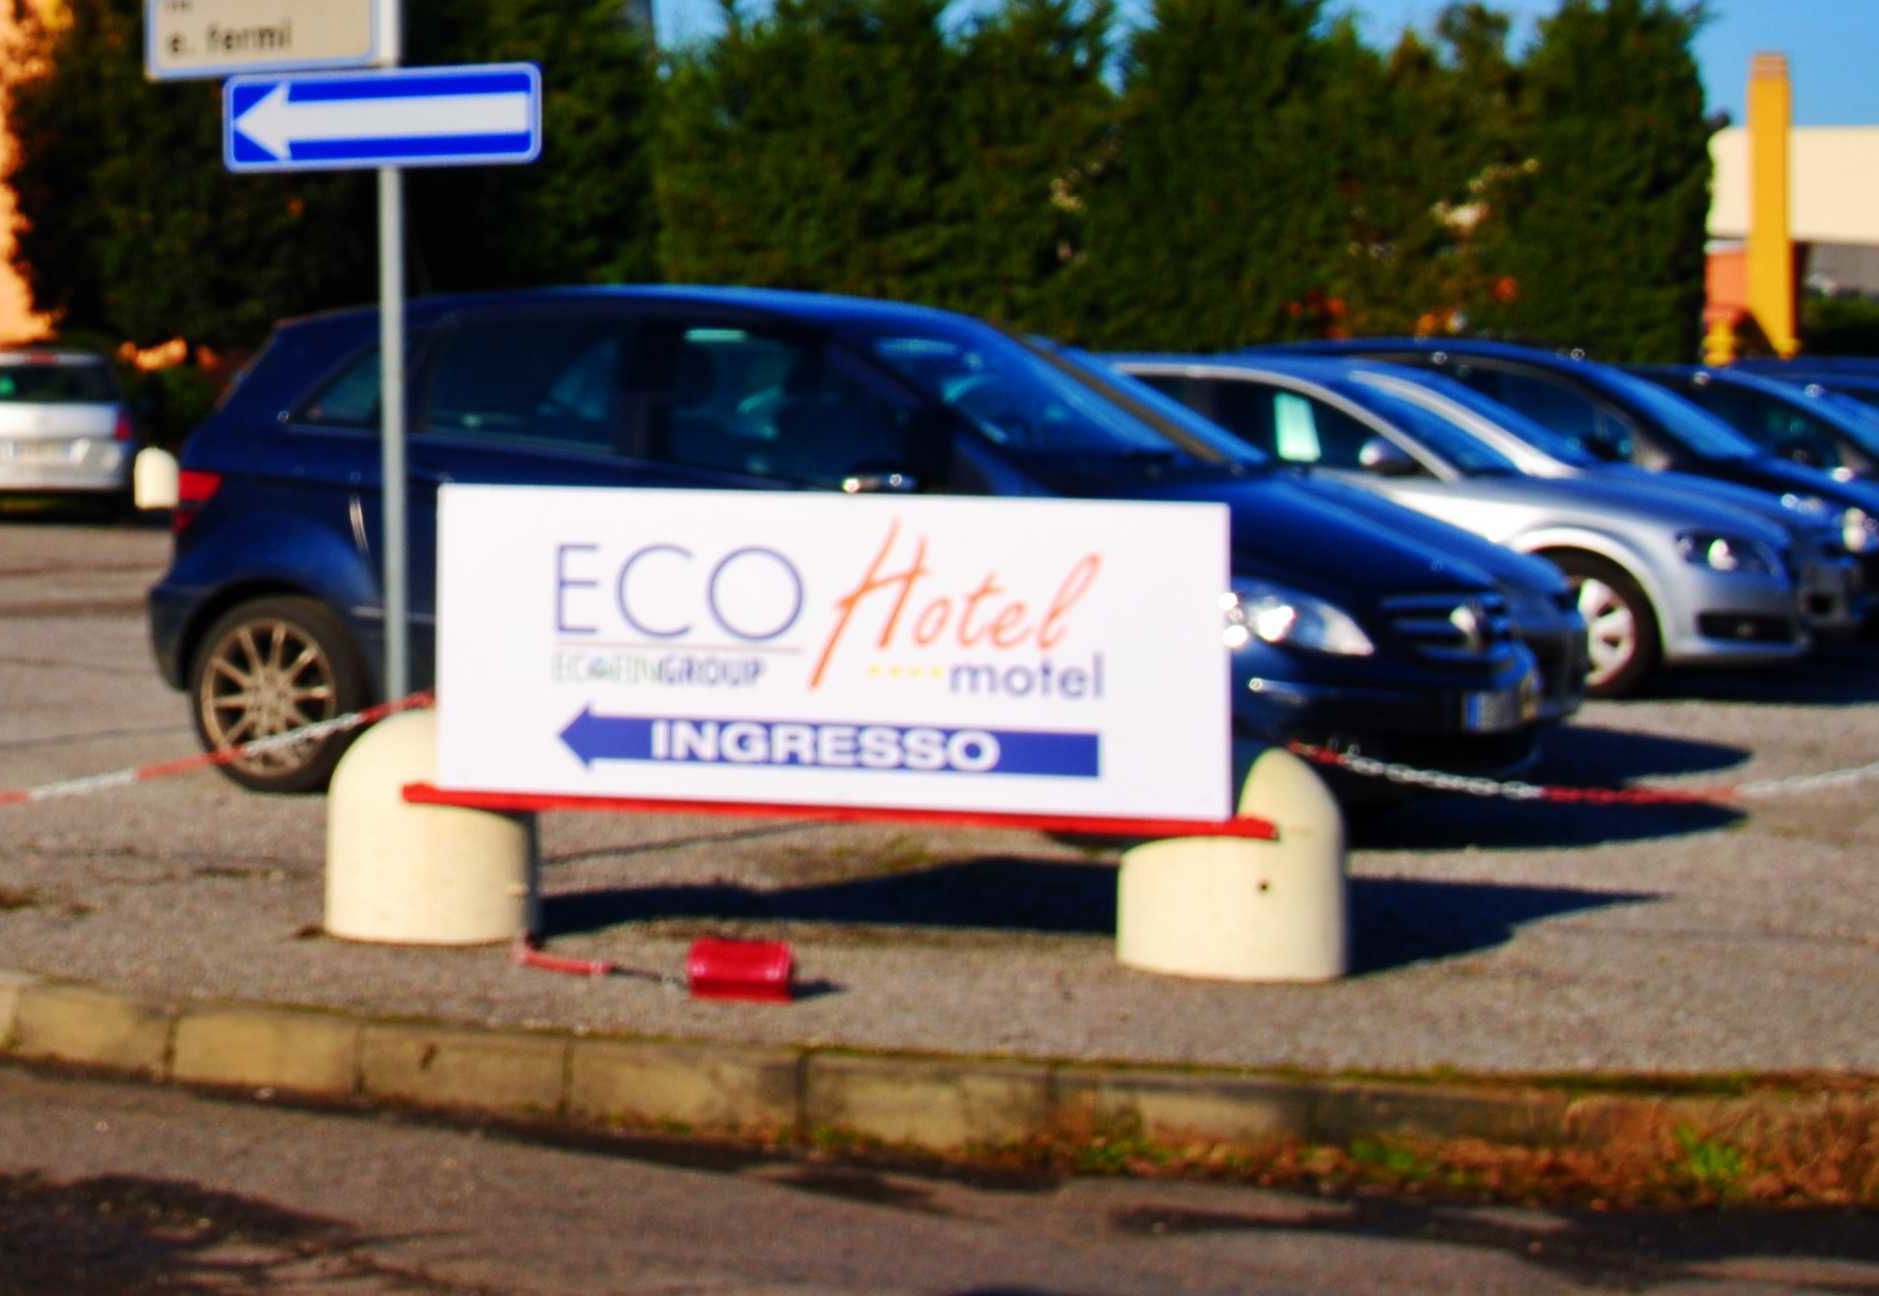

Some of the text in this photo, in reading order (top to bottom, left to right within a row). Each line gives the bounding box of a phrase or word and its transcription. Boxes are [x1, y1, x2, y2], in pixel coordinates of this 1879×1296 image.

[554, 516, 1102, 689] ECO Hotel
[948, 651, 1107, 700] motel
[650, 718, 1002, 773] INGRESSO
